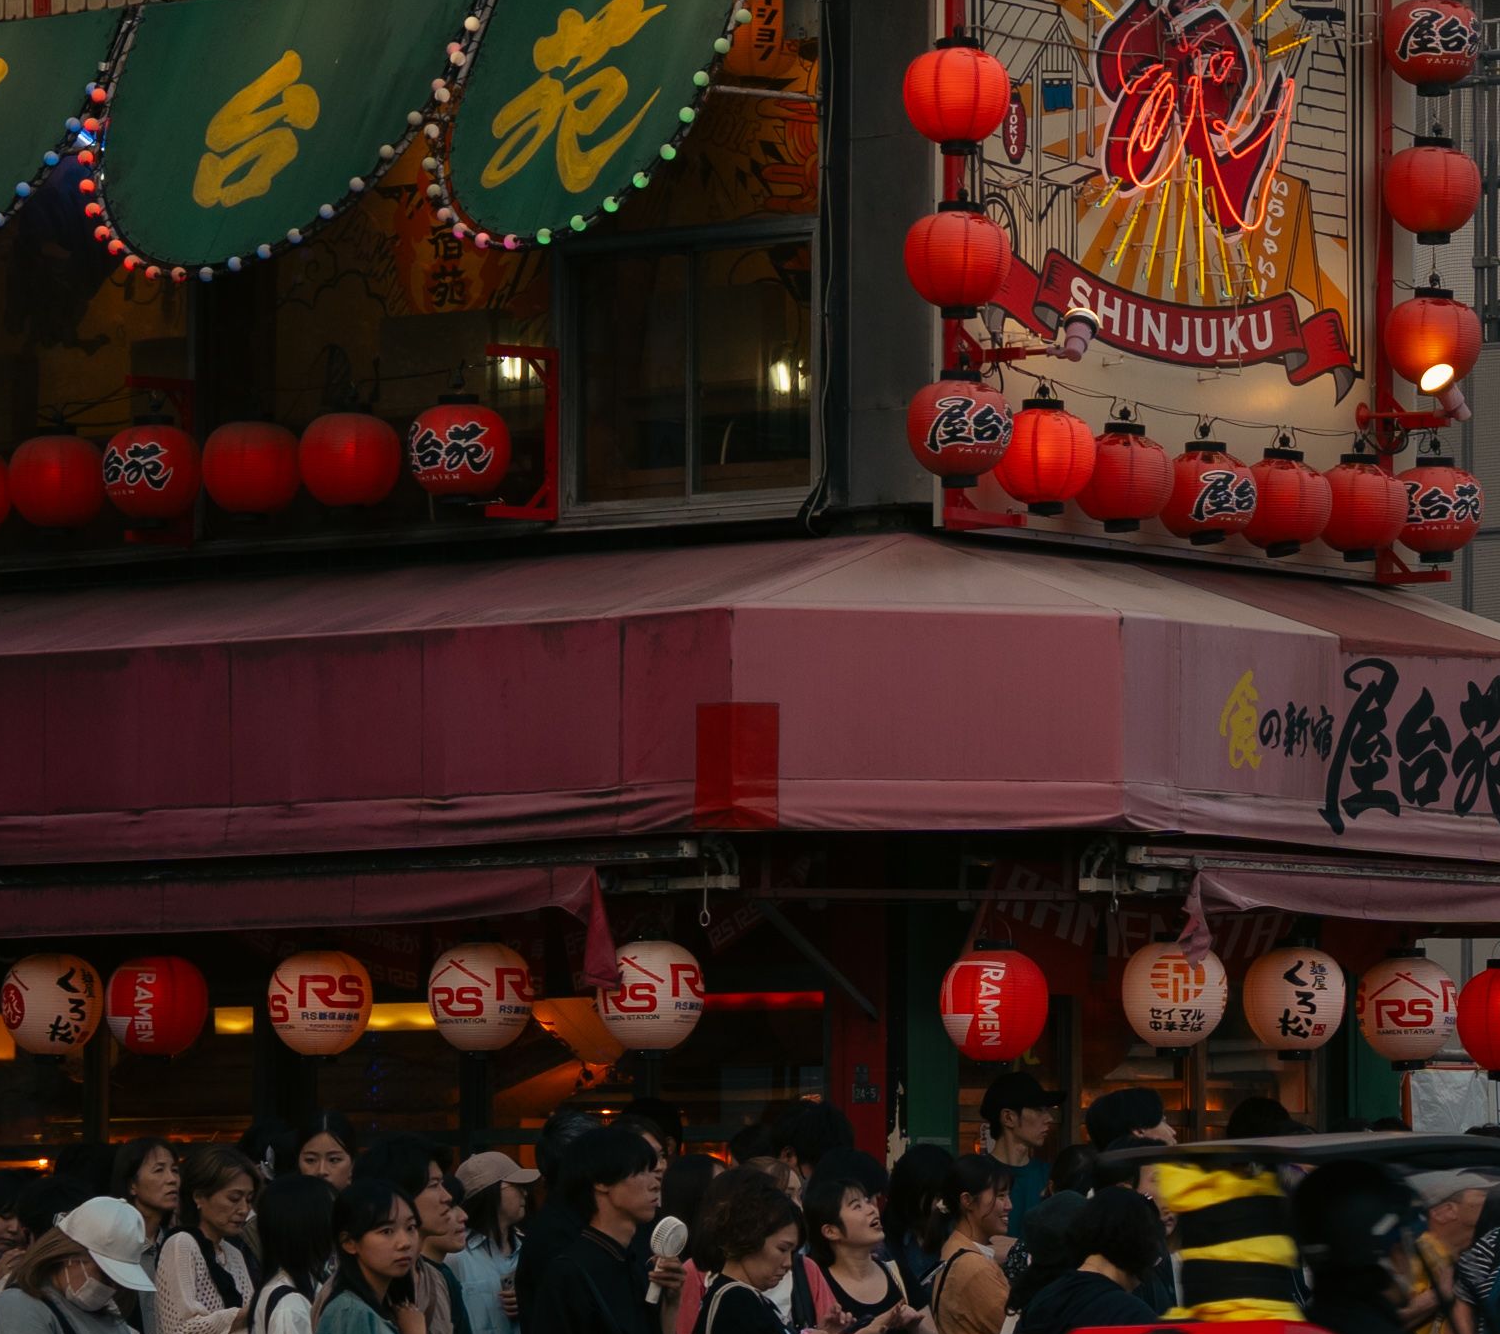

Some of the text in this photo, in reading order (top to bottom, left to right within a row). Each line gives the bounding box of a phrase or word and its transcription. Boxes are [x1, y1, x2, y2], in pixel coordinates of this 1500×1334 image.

[191, 50, 321, 210] 台
[1008, 103, 1019, 156] TOKYO
[1067, 275, 1275, 359] SHINJUKU
[406, 419, 496, 475] 台苑
[924, 395, 1014, 454] 屋台
[1220, 669, 1334, 771] 食の新宿
[50, 967, 87, 1045] くろ松
[134, 971, 156, 1043] RAMEN
[268, 993, 290, 1023] S
[297, 974, 365, 1009] RS
[431, 986, 484, 1018] RS
[601, 982, 657, 1015] RS
[978, 966, 1008, 1048] RAMEN
[1150, 1007, 1205, 1020] セイマル
[1278, 960, 1318, 1039] くろ松
[1374, 998, 1435, 1029] RS
